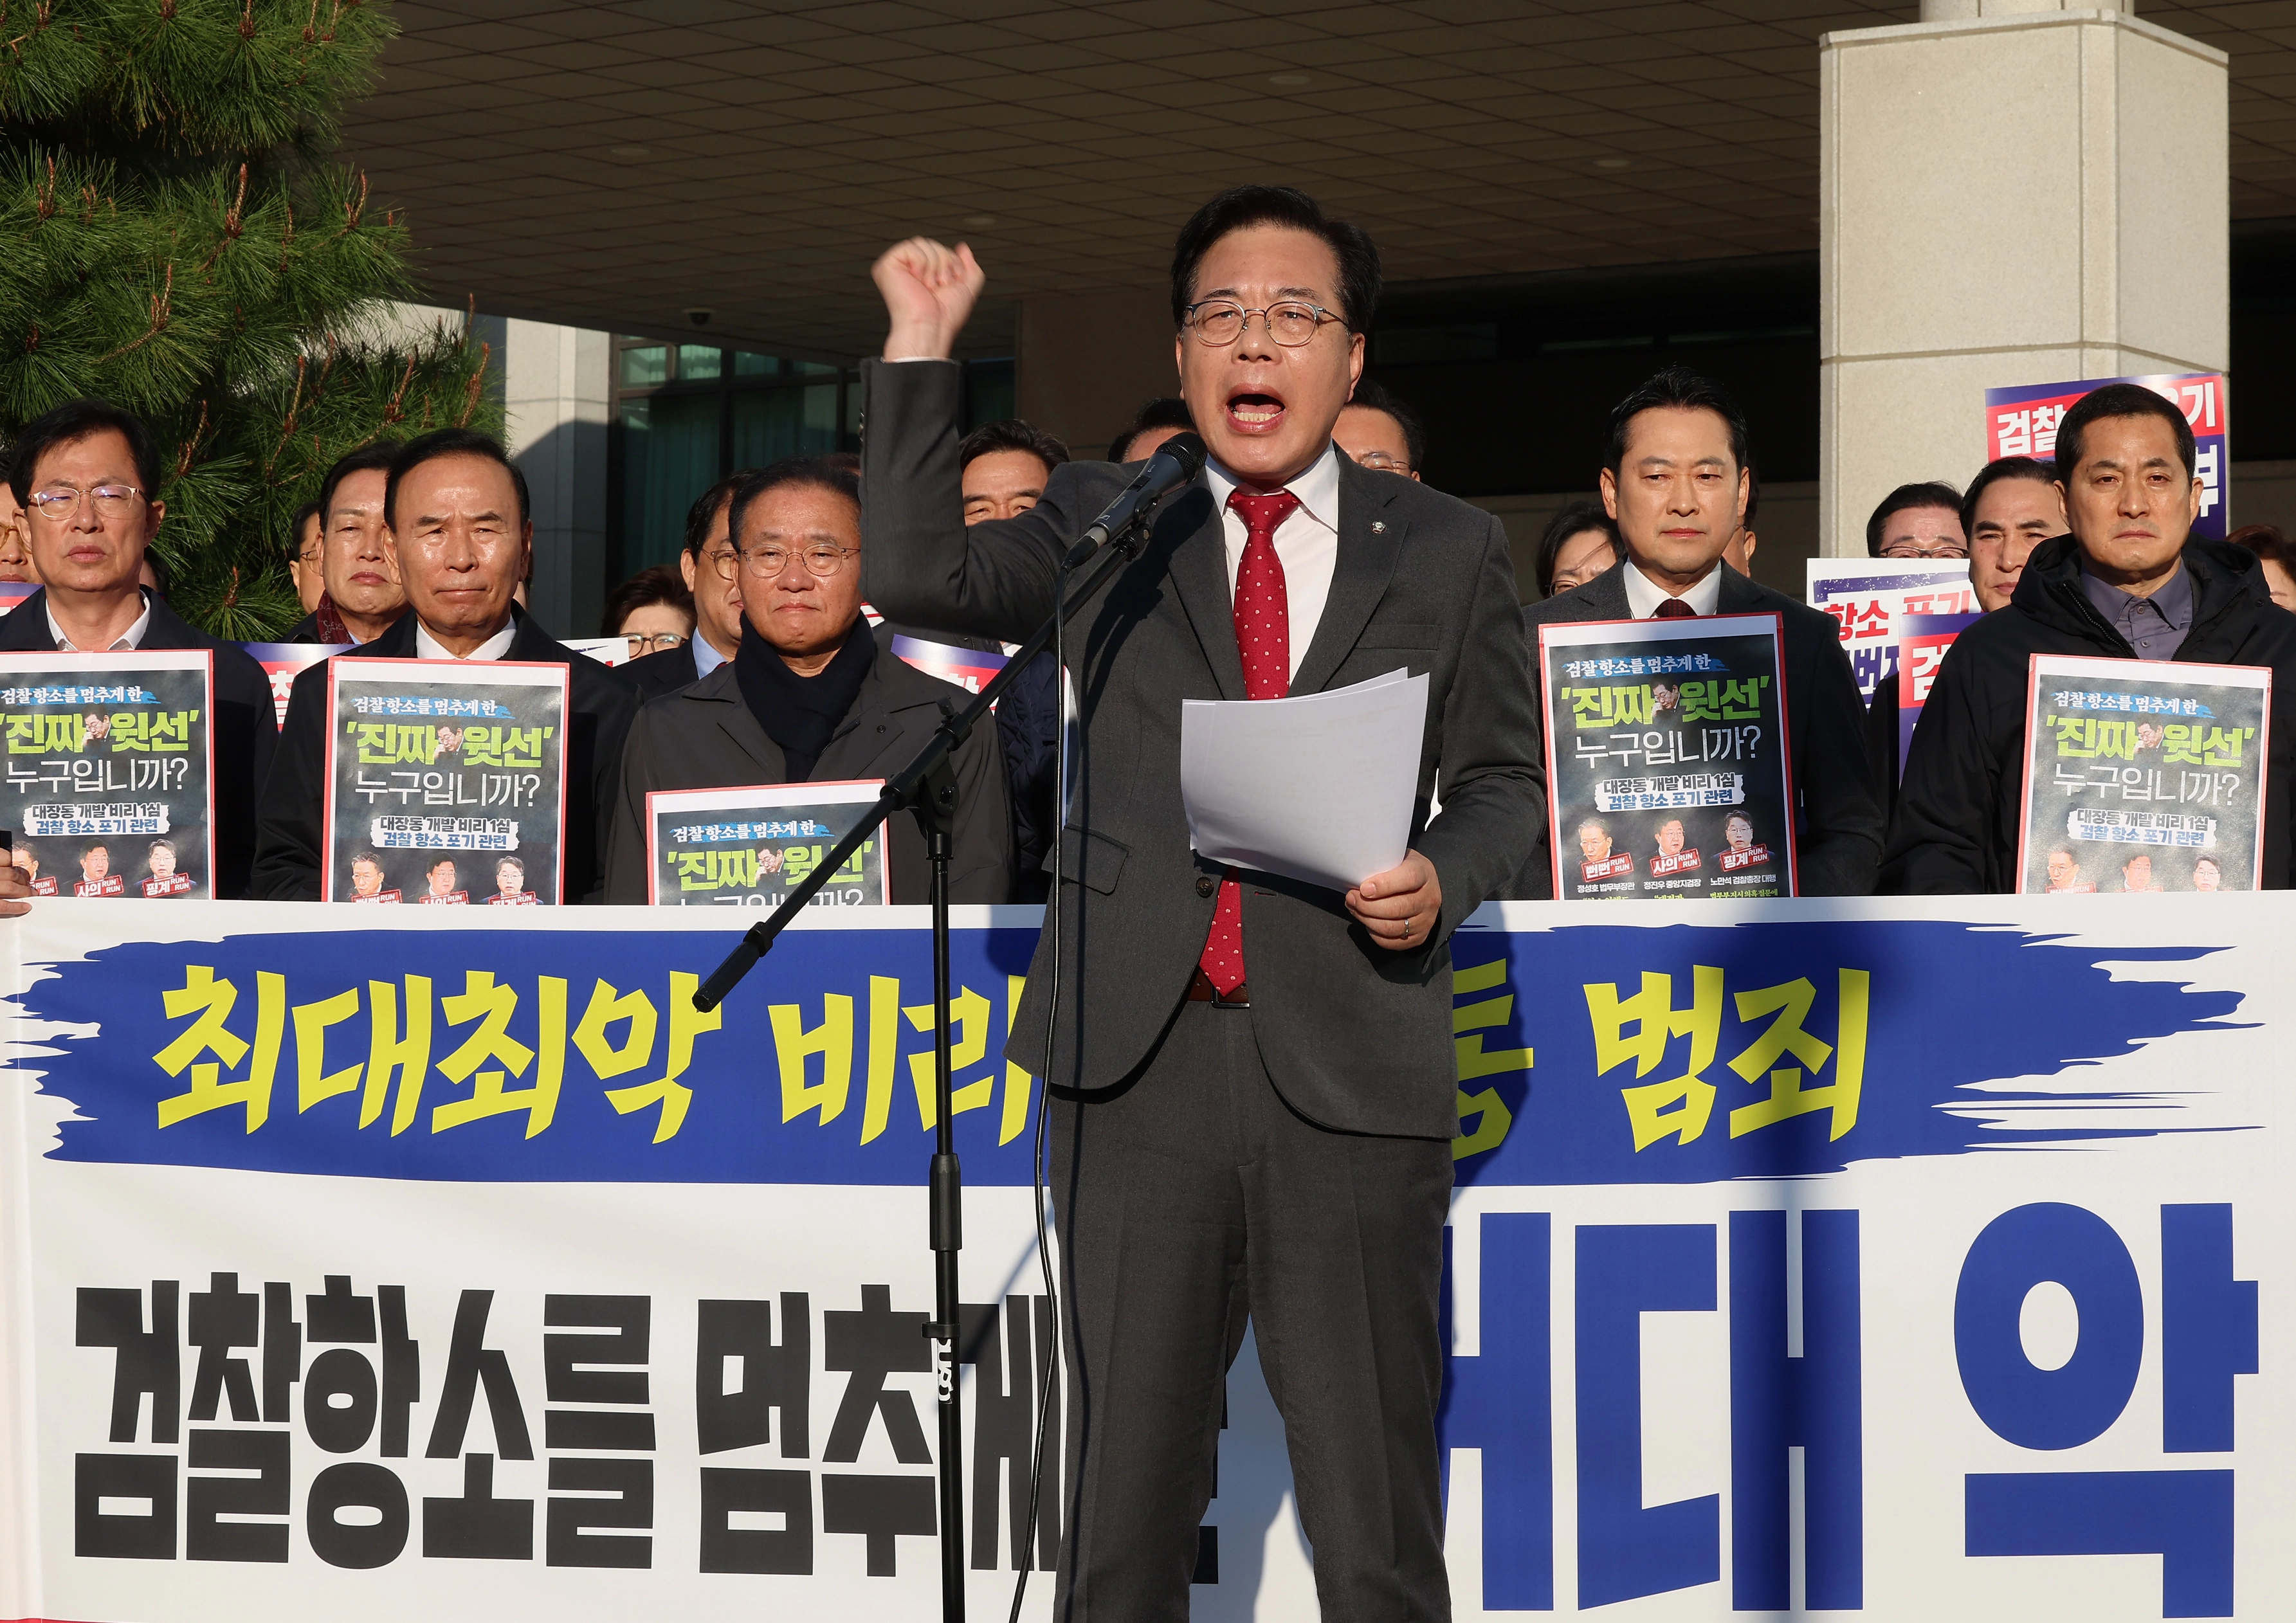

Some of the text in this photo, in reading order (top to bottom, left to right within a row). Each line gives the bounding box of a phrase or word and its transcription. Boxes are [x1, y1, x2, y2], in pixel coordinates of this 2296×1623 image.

[1823, 600, 1889, 641] 항소
[1566, 653, 1711, 678] 검찰 항소를 멈추게 한
[1, 685, 143, 705] 검찰 항소를 멈추게 한
[2053, 691, 2200, 716] 검찰 항소를 멈추게 한
[353, 696, 498, 716] 검찰 항소를 멈추게 한
[1575, 725, 1762, 768] 누구입니까?
[6, 757, 189, 794] 누구입니까?
[1603, 772, 1735, 793] 대장동 개발 비리 1심
[2053, 763, 2241, 806] 누구입니까?
[354, 770, 540, 807] 누구입니까?
[1608, 788, 1733, 810] 검찰 항소 포기 관련
[33, 802, 161, 819] 대장동 개발 비리 1심
[2077, 808, 2209, 831] 대장동 개발 비리 1심
[37, 818, 158, 834] 검찰 항소 포기 관련
[380, 816, 511, 833] 대장동 개발 비리 1심
[672, 819, 817, 843] 검찰 항소를 멈추게 한
[384, 832, 507, 849] 검찰 항소 포기 관련
[2080, 824, 2205, 847] 검찰 항소 포기 관련
[1585, 862, 1610, 878] 뻔뻔
[1654, 858, 1678, 874] 사의
[1724, 854, 1749, 869] 핑계
[146, 881, 171, 895] 핑계
[1577, 883, 1635, 893] 정성호 법무부장관
[1643, 878, 1702, 890] 정진우 중앙지검장
[1710, 874, 1776, 886] 노만석 검찰총장 대행
[152, 965, 722, 1145] 최대최악
[768, 975, 1031, 1147] 비리
[1583, 964, 1870, 1154] 범죄
[1954, 1202, 2259, 1619] 악
[75, 1272, 656, 1570] 검찰항소를
[697, 1284, 1061, 1577] 멈추게
